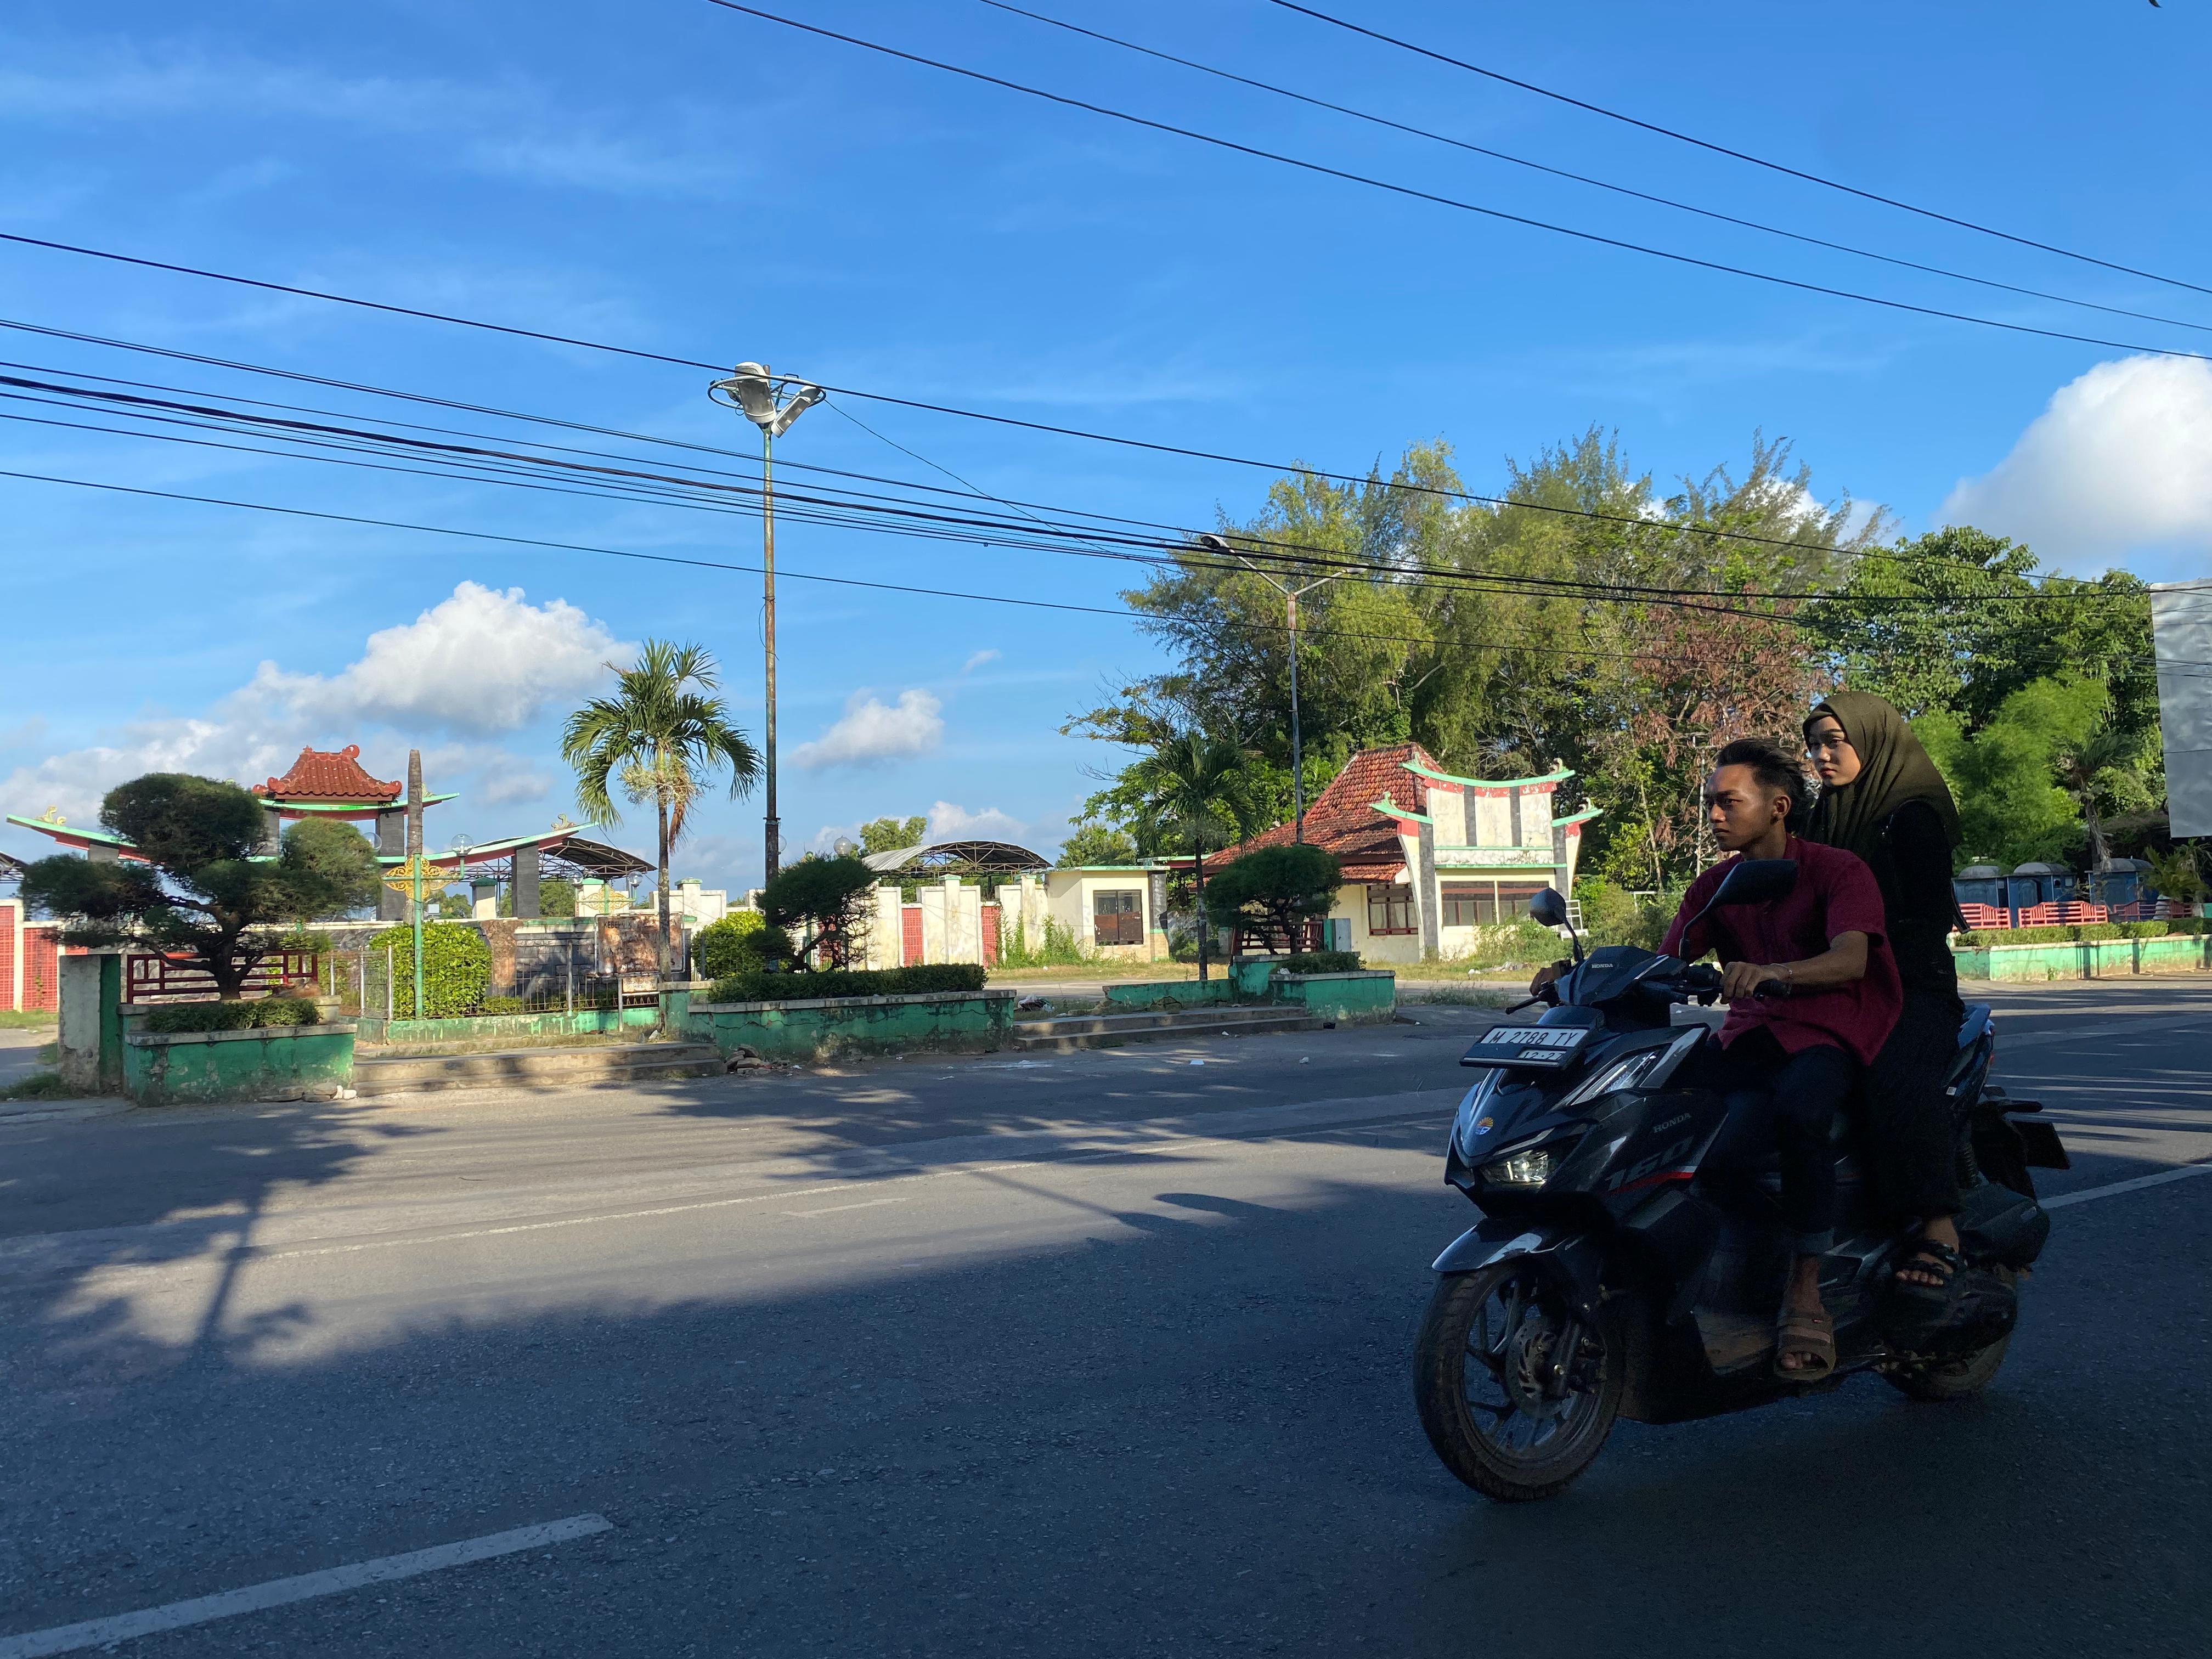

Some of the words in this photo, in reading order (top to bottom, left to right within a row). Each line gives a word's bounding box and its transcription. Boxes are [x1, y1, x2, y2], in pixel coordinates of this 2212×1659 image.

[1488, 1031, 1506, 1044] M
[1509, 1031, 1549, 1045] 2788
[1553, 1032, 1578, 1046] TY
[1652, 1113, 1692, 1133] HONDA
